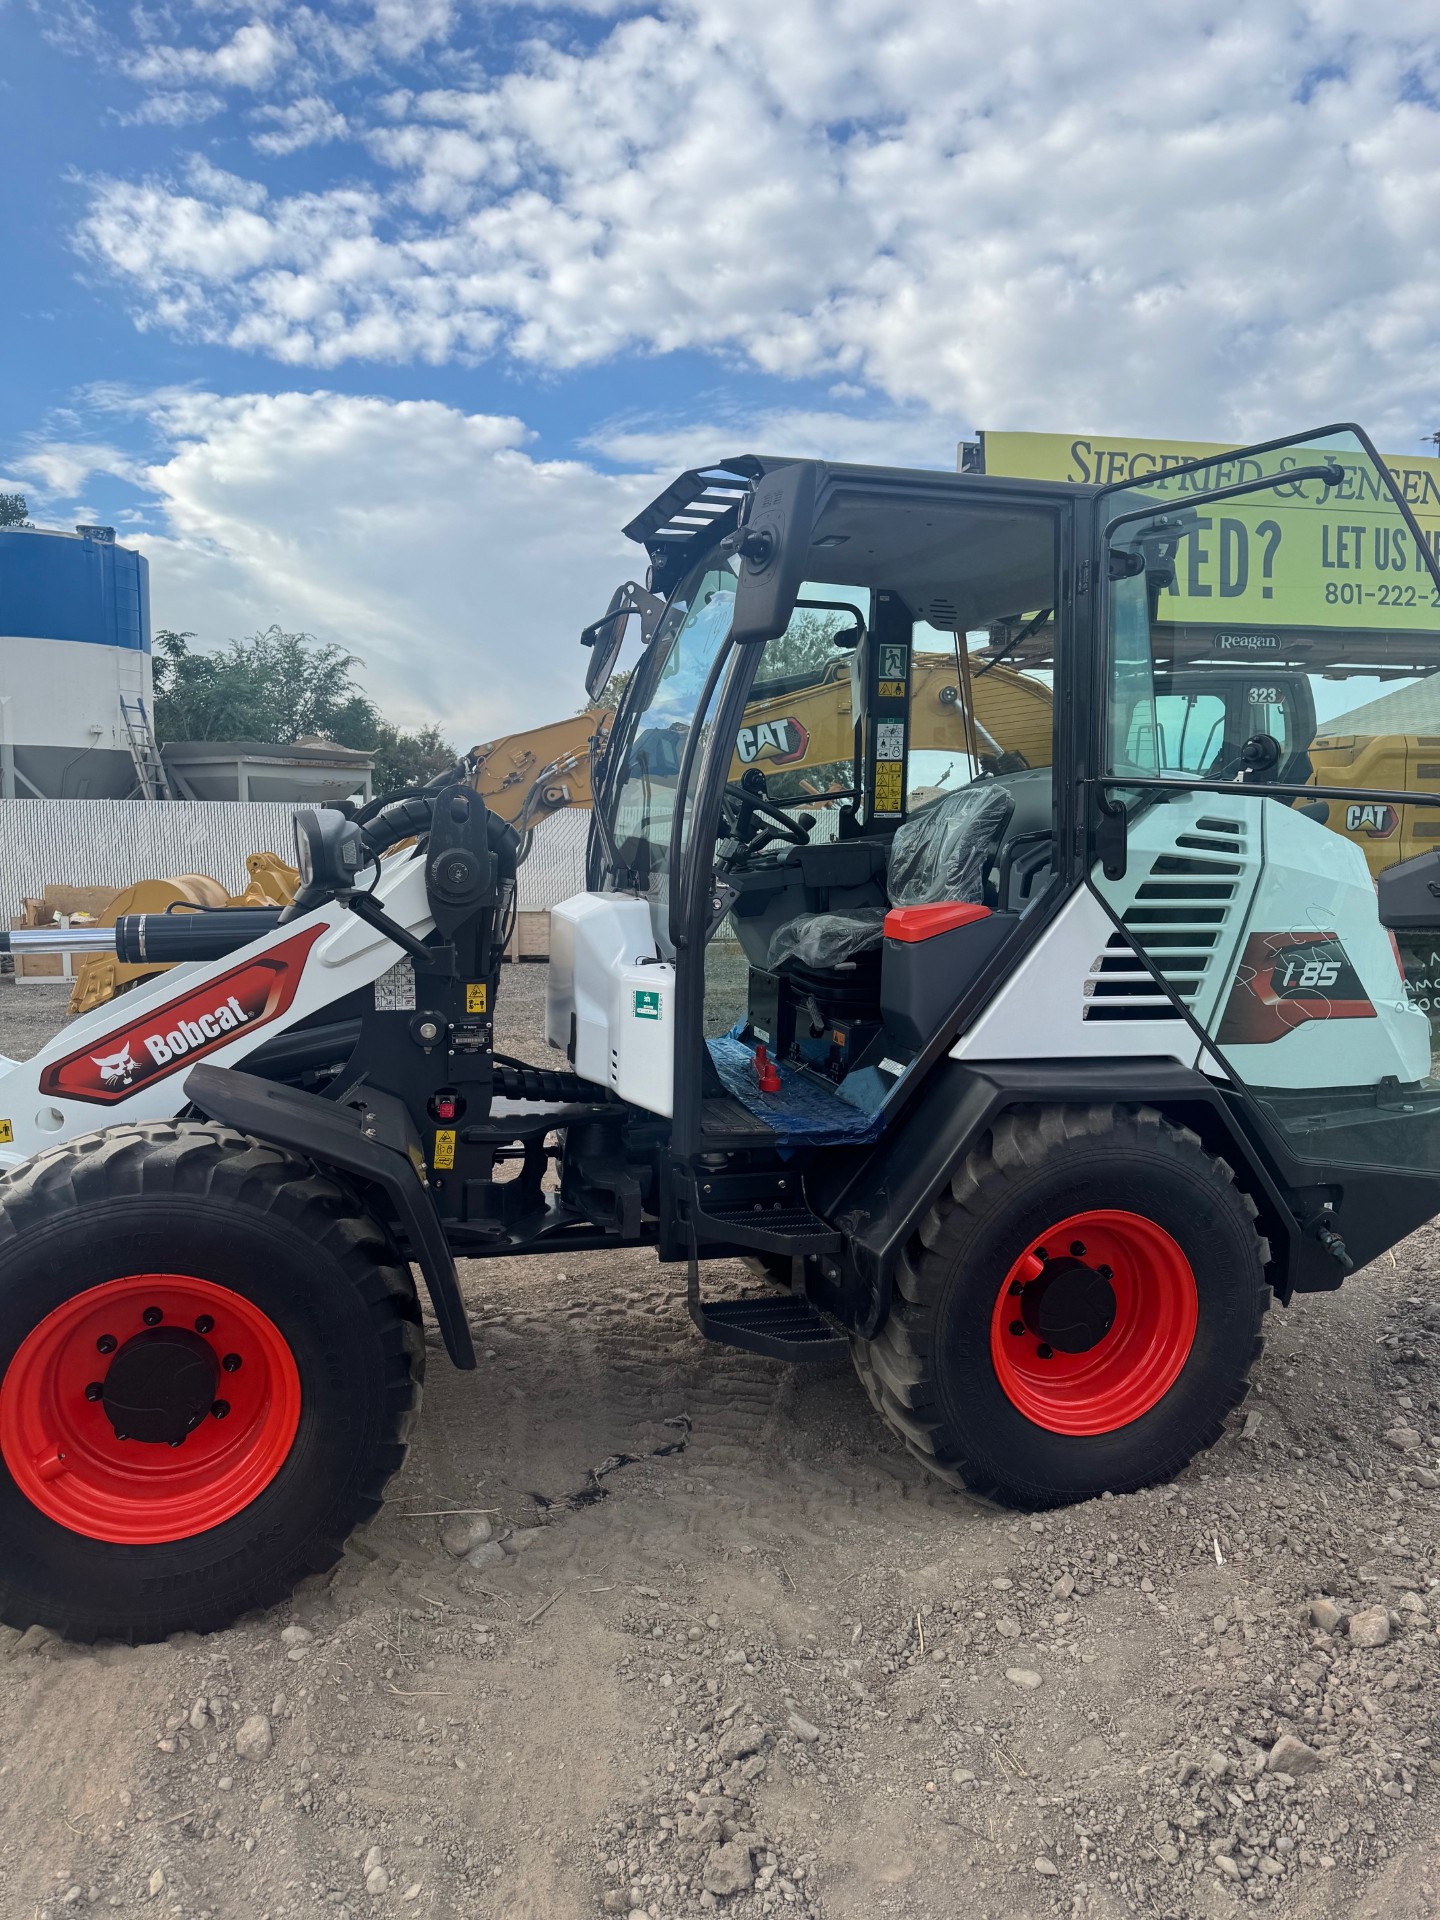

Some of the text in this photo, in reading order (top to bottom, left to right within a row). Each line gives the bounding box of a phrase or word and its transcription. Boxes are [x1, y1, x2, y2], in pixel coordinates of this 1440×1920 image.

[1272, 456, 1309, 499] &
[1160, 517, 1282, 599] ED?
[1322, 524, 1366, 569] LET
[1374, 527, 1407, 571] US
[1220, 635, 1276, 650] Reagan
[1249, 687, 1277, 703] 323
[736, 718, 790, 762] CAT
[1347, 805, 1387, 831] CAT
[143, 996, 249, 1066] Bobcat
